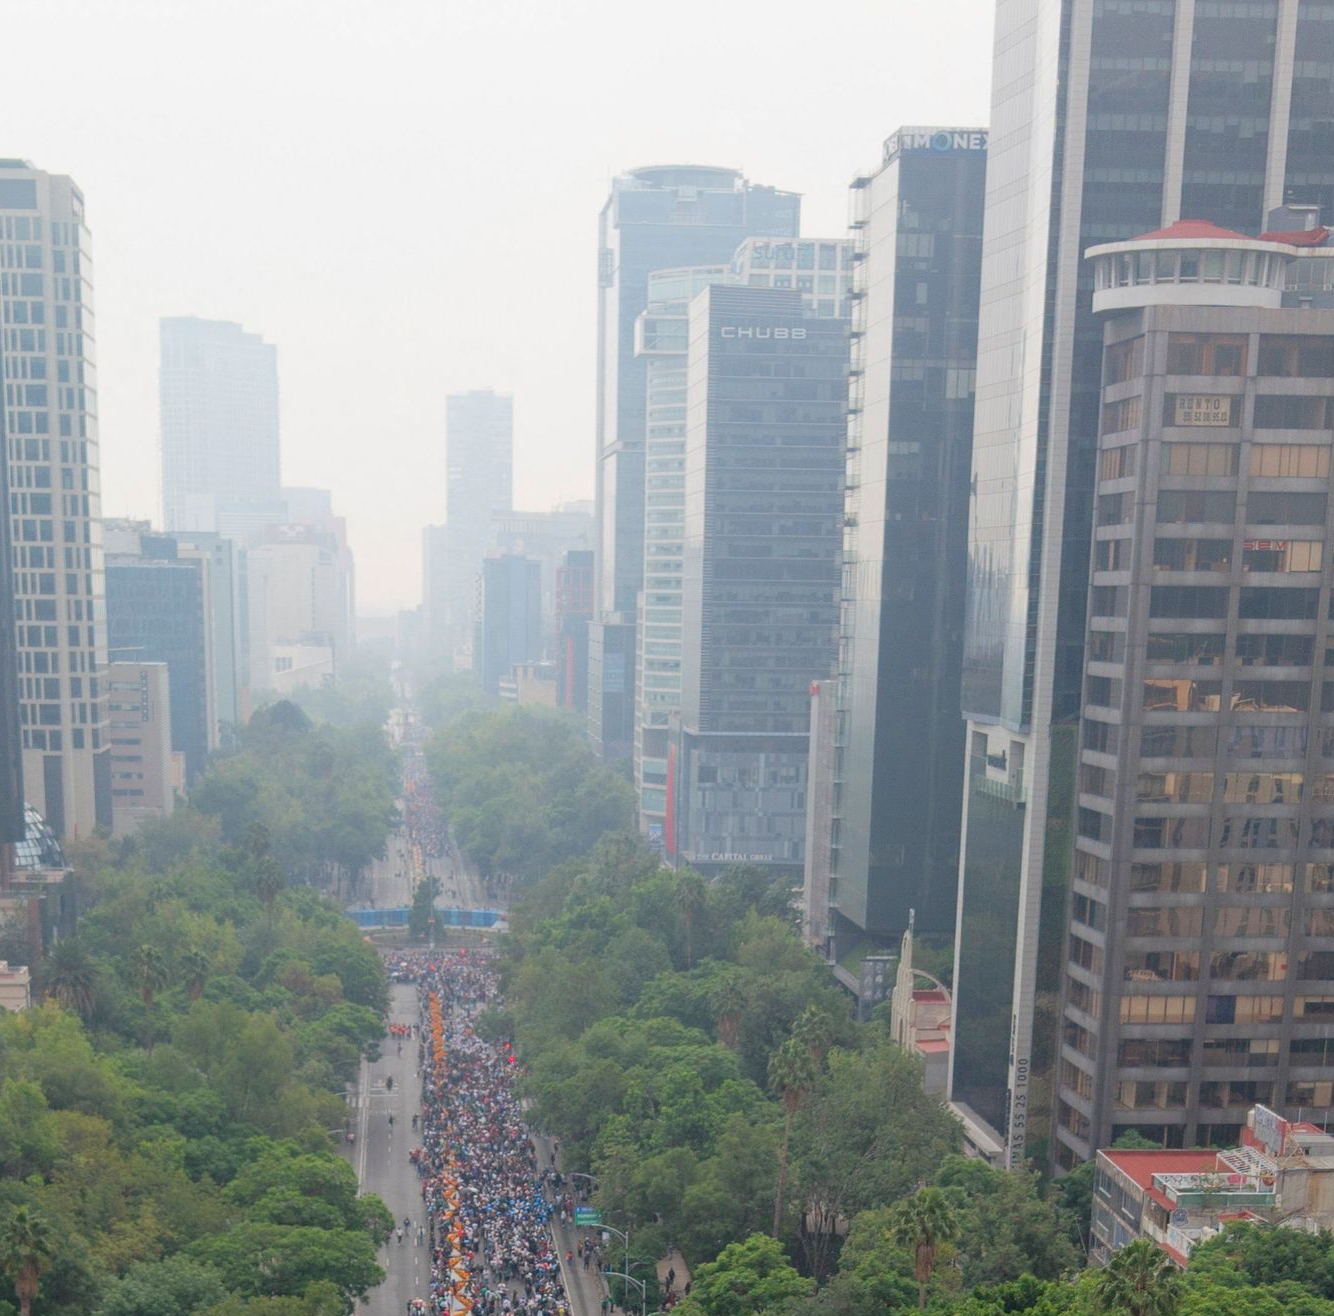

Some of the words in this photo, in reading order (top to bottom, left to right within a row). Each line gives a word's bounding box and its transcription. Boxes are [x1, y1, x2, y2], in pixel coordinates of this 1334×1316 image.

[721, 326, 807, 339] CHUBB
[711, 852, 748, 861] CAPITAL
[1017, 1058, 1029, 1087] 1000
[1016, 1094, 1026, 1108] 25
[1014, 1113, 1025, 1128] 55
